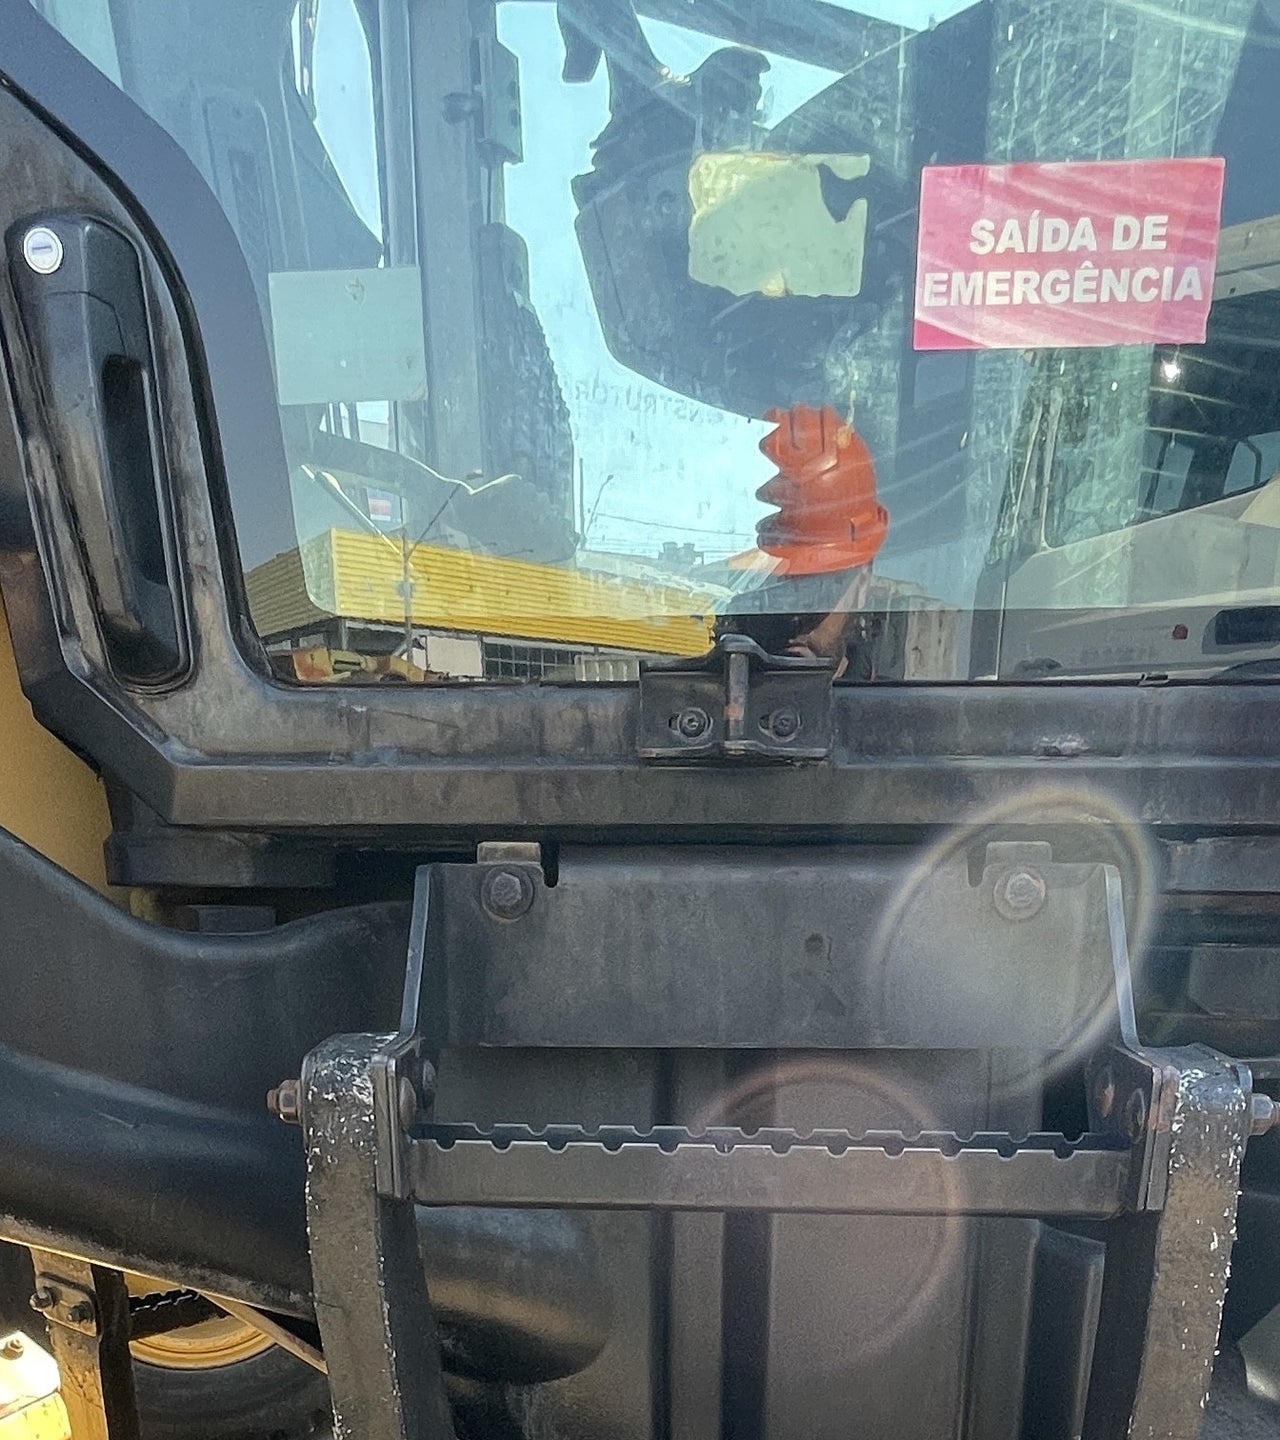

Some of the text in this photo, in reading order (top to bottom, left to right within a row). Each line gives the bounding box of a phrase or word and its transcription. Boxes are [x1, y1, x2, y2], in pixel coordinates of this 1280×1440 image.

[969, 209, 1169, 255] SAÍDA DE
[922, 261, 1203, 307] EMERGÊNCIA
